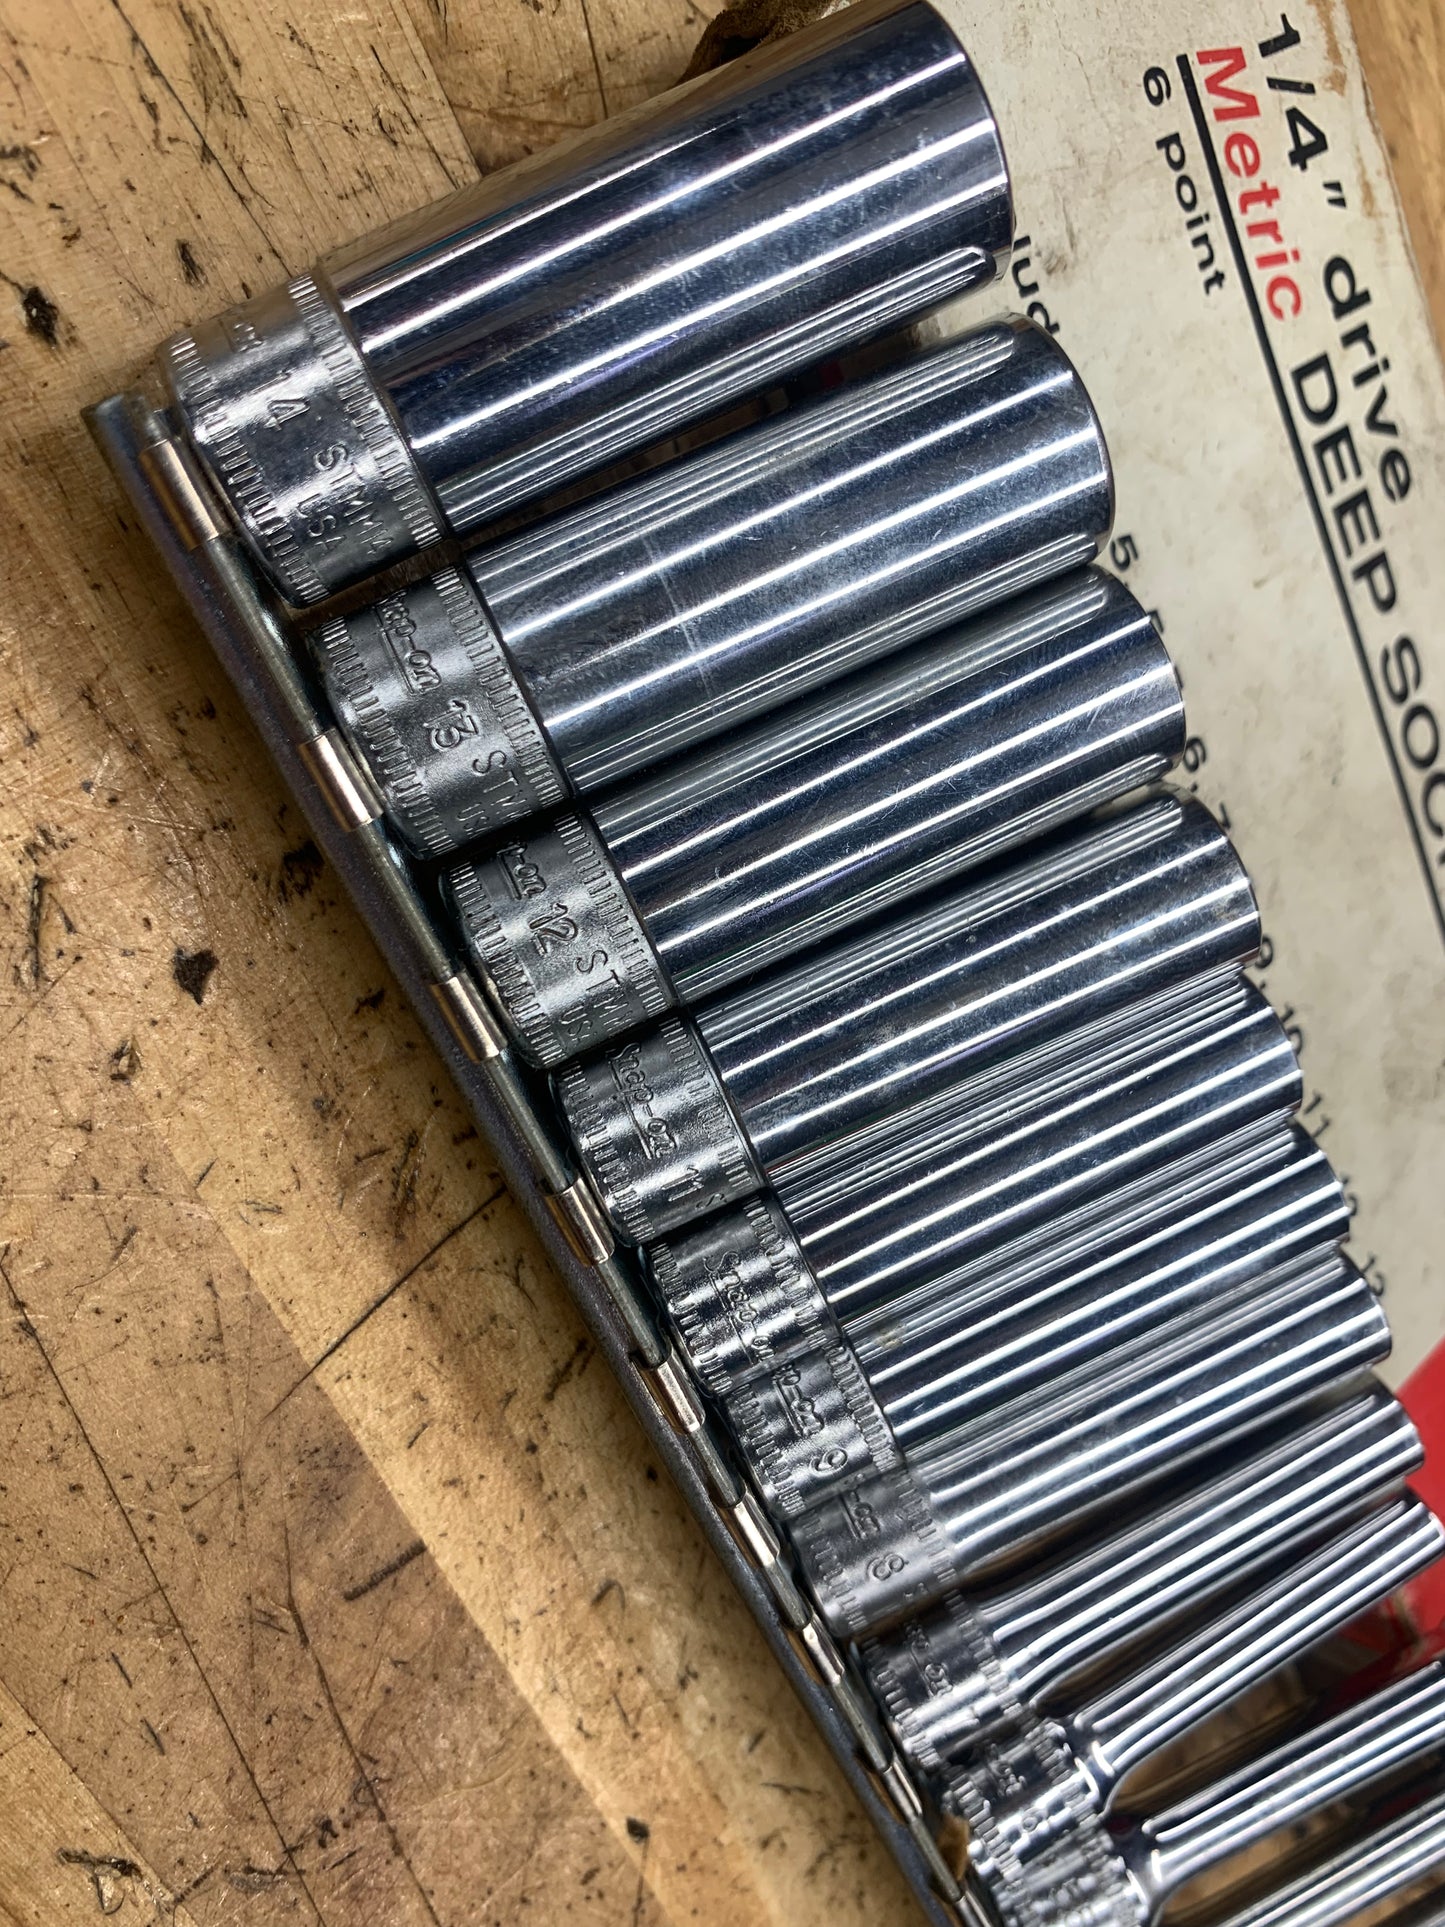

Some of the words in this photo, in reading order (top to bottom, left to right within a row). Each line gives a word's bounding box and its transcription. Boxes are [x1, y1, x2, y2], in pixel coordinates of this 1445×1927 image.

[1142, 66, 1172, 107] 6
[1156, 132, 1228, 296] point
[1259, 14, 1347, 208] 1/4"
[1323, 255, 1413, 504] drive
[1197, 46, 1302, 320] Metric
[1290, 353, 1397, 614] DEEP
[1382, 637, 1445, 866] SOC
[293, 491, 348, 559] USA
[418, 695, 483, 757] 13
[522, 899, 583, 959] 12
[599, 1037, 688, 1164] Snap-on
[806, 1443, 852, 1481] 9
[861, 1545, 912, 1588] 8
